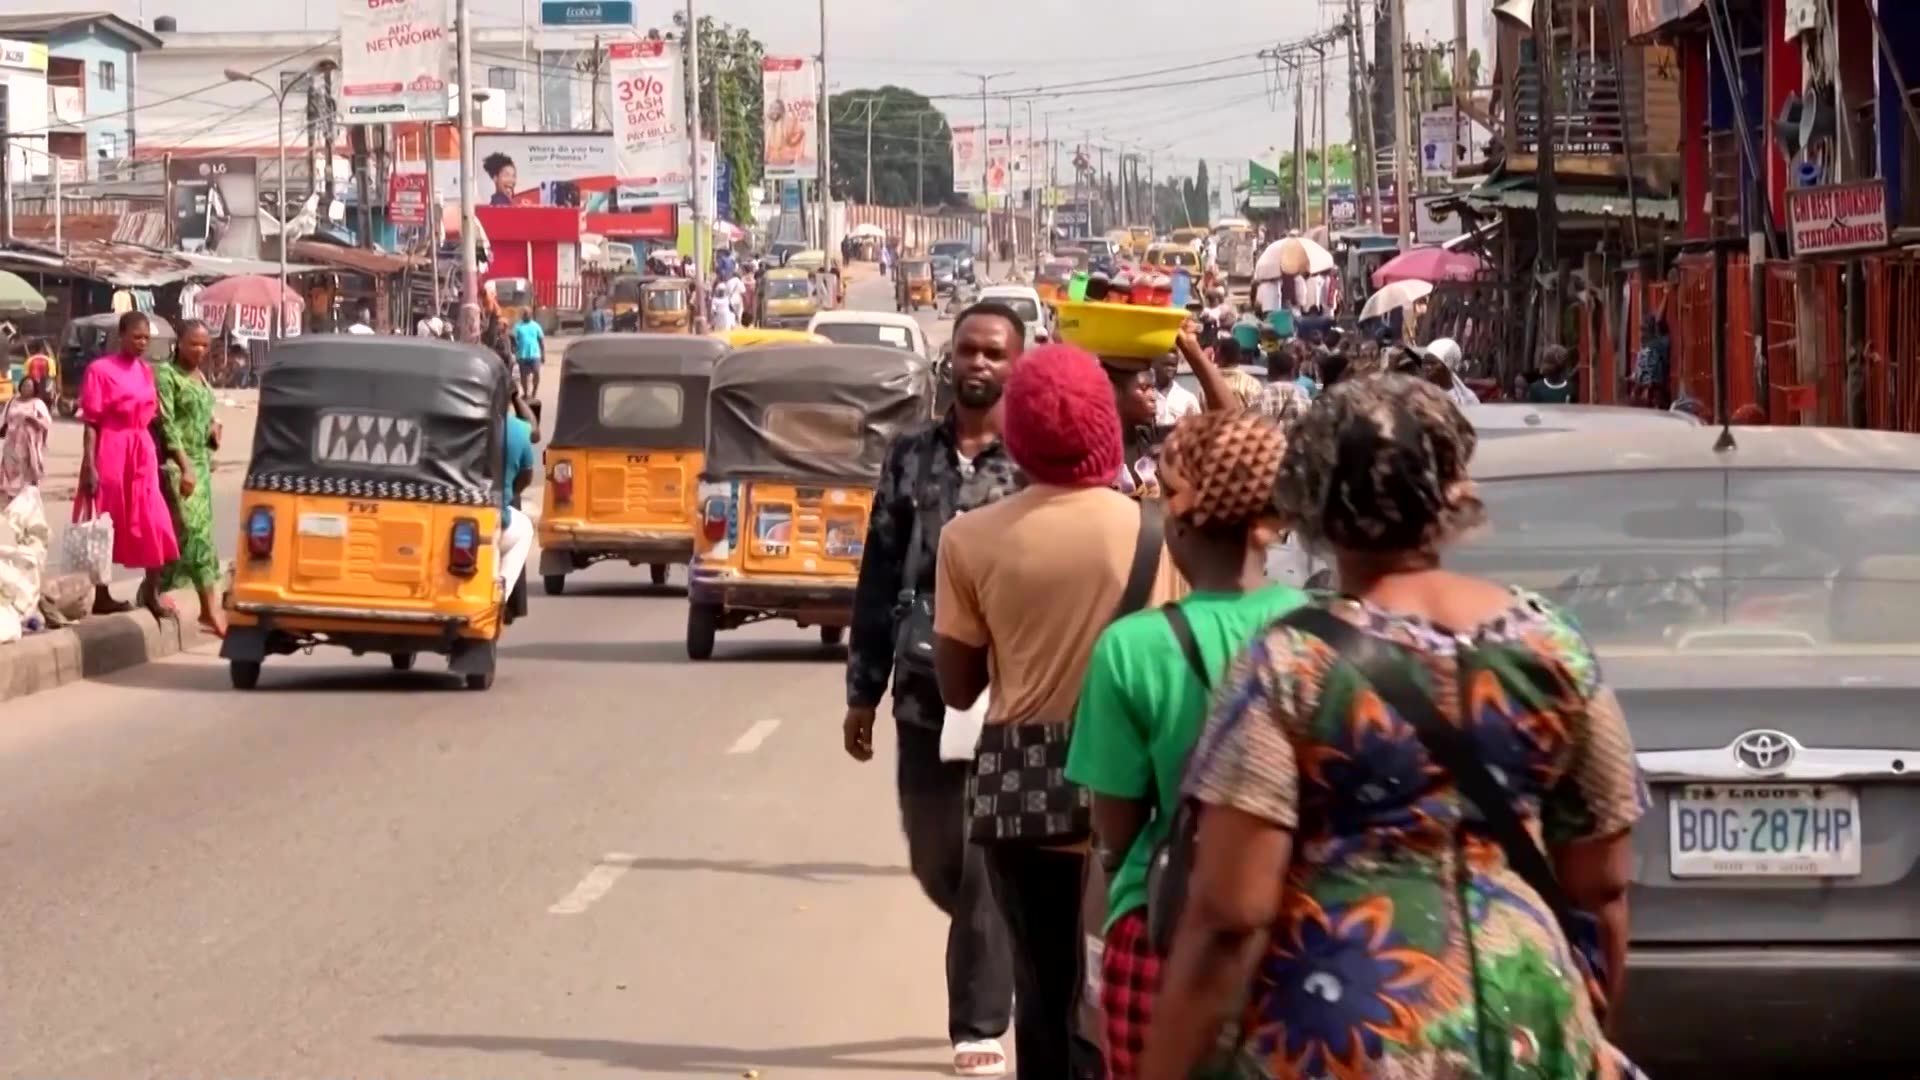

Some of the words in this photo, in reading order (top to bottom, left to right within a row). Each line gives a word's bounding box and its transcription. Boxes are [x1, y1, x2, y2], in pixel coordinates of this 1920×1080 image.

[566, 5, 602, 17] Ecobank
[388, 23, 412, 35] ANY
[366, 28, 442, 53] NETWORK
[617, 75, 664, 101] 3%
[625, 96, 663, 113] CASH
[628, 108, 665, 125] BACK
[627, 131, 644, 142] PAY
[647, 124, 677, 137] BILLS
[528, 145, 555, 153] Where
[558, 145, 569, 153] do
[571, 147, 587, 155] you
[589, 145, 604, 154] buy
[212, 163, 227, 174] LG
[1810, 192, 1832, 220] BEST
[626, 455, 650, 464] TVS
[347, 501, 380, 514] TVS
[1728, 788, 1800, 799] LAGOS
